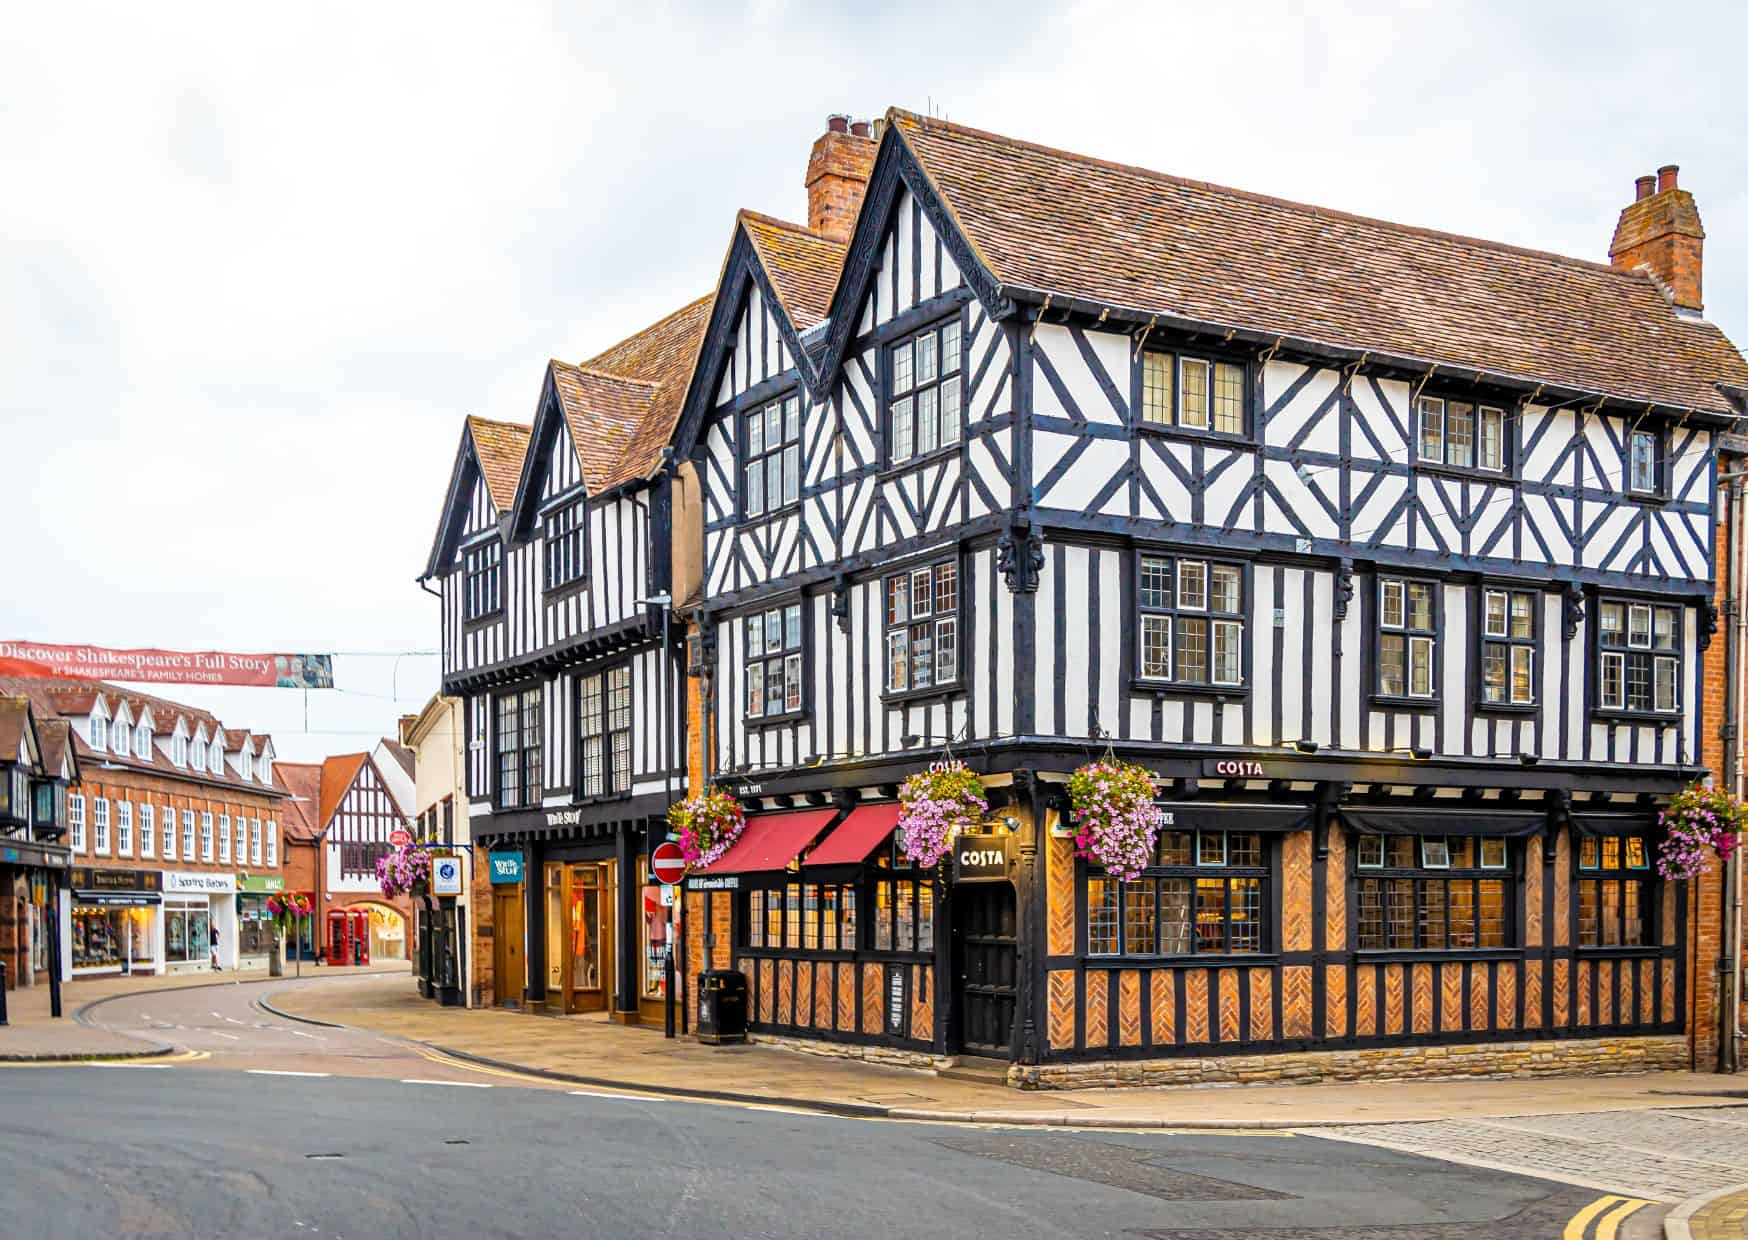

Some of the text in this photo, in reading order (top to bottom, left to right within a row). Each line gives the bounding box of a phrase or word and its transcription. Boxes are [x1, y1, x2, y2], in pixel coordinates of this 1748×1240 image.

[0, 643, 270, 674] Discover Shakespeare's Full Story
[146, 669, 182, 681] FAMILY
[184, 670, 224, 683] HOMES
[1216, 761, 1264, 776] COSTA
[960, 850, 1004, 867] COSTA
